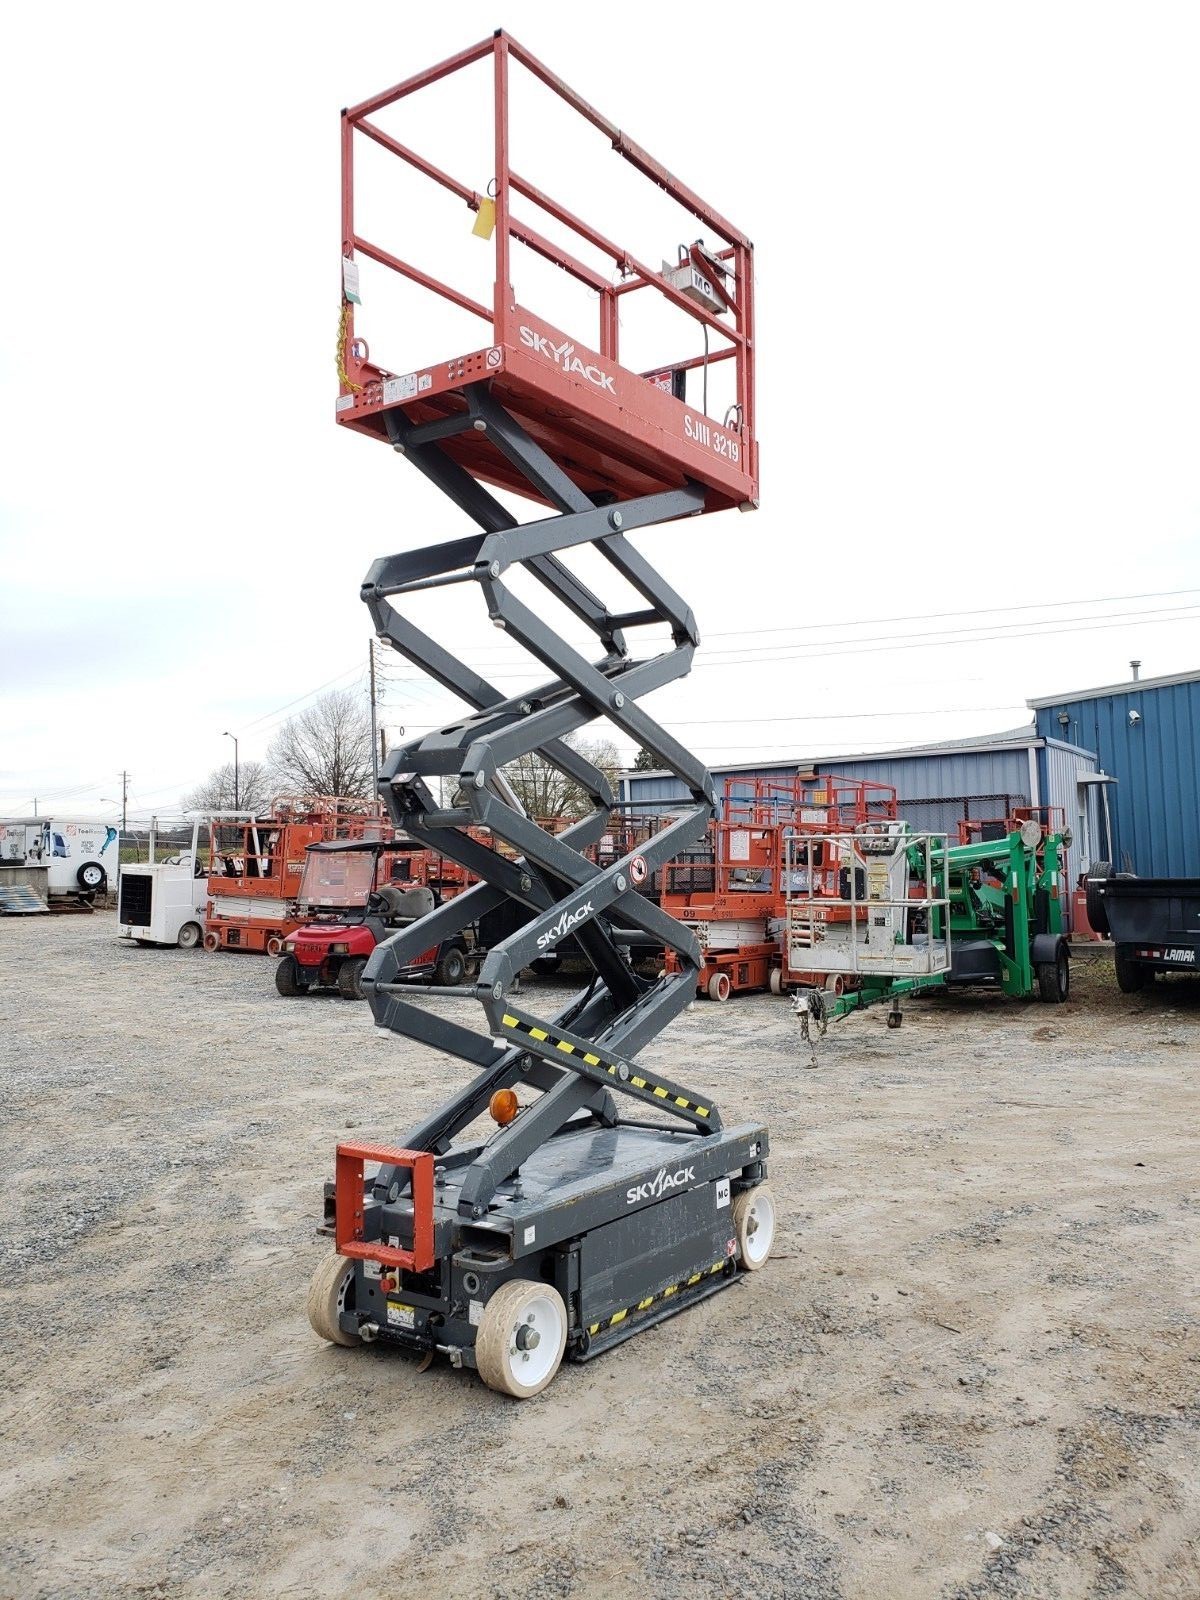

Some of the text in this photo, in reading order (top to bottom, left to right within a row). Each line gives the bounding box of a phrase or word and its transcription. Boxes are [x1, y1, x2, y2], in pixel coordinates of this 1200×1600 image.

[695, 273, 711, 295] MC
[519, 326, 617, 395] SKYJACK
[684, 414, 739, 462] SJIII 3219
[537, 901, 595, 949] SKYJACK
[683, 910, 696, 918] 09
[626, 1165, 696, 1205] SKYJACK
[718, 1188, 729, 1199] MC
